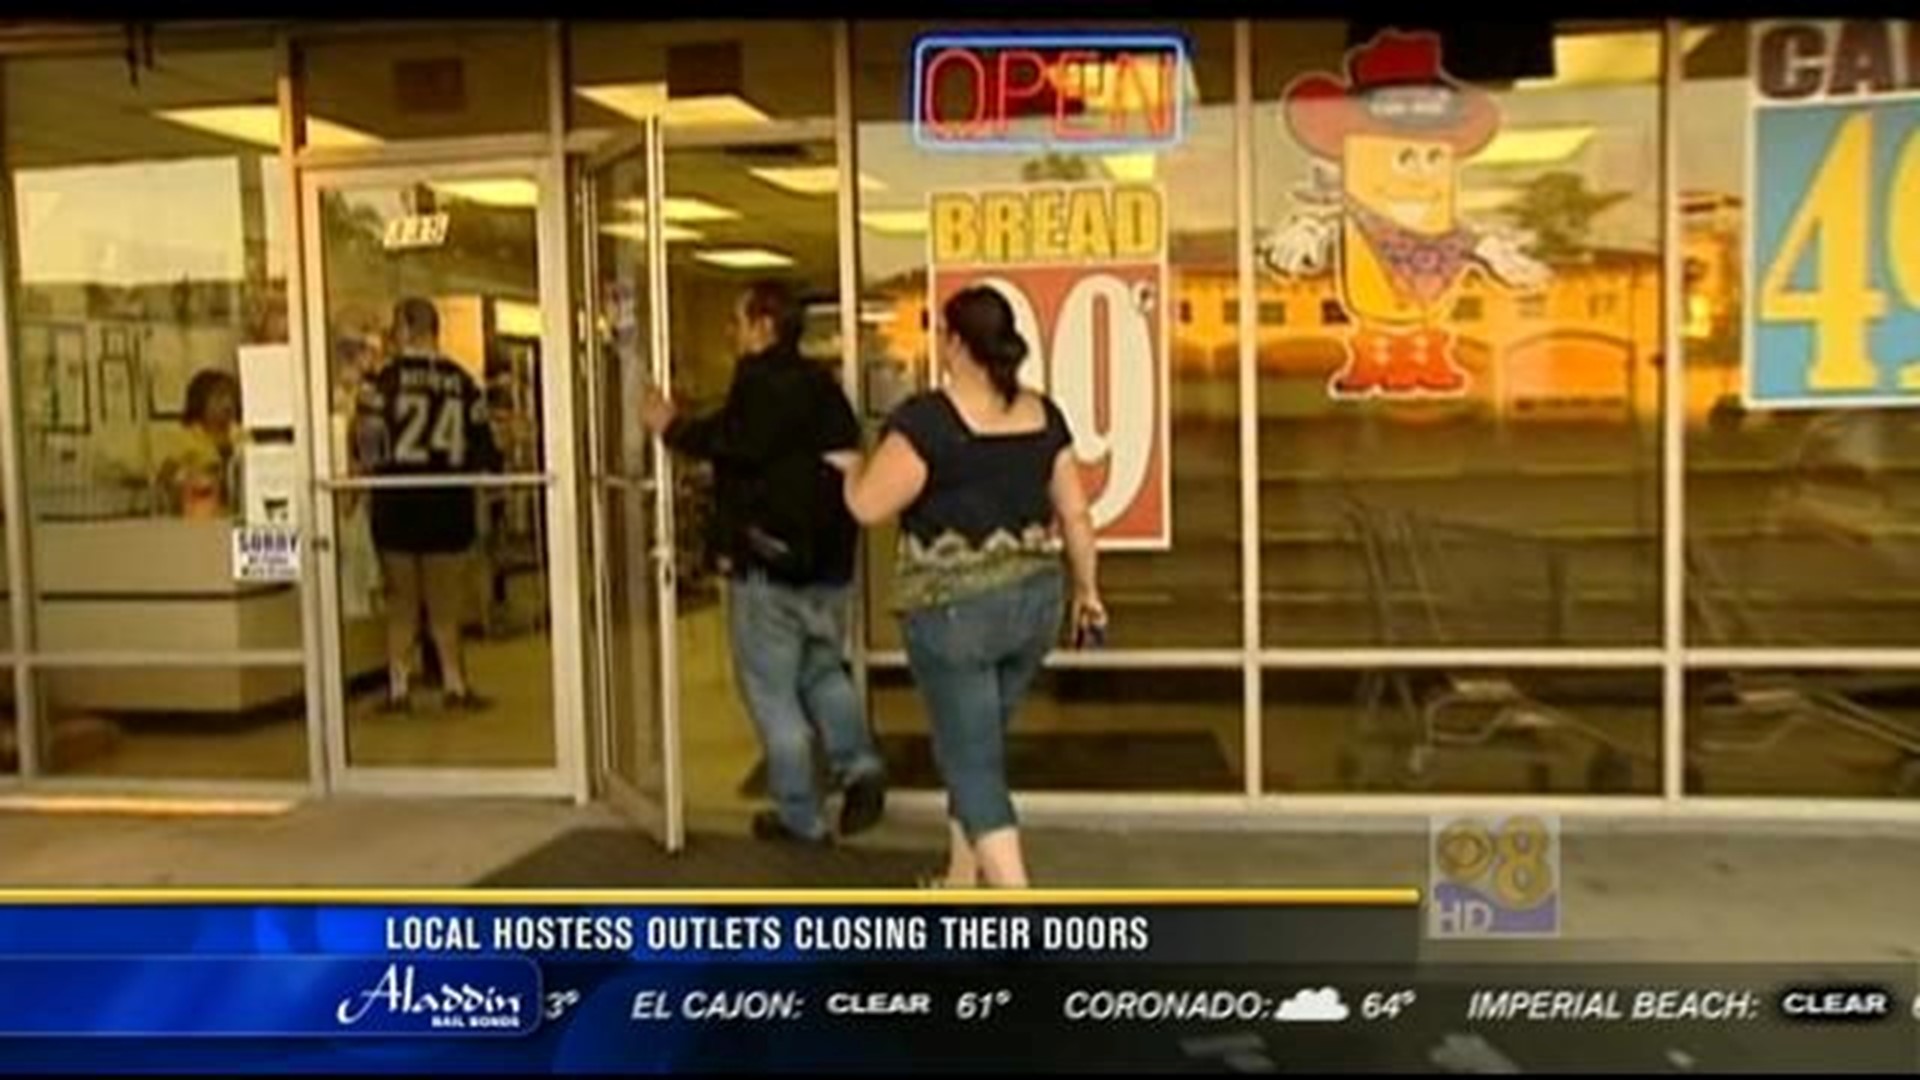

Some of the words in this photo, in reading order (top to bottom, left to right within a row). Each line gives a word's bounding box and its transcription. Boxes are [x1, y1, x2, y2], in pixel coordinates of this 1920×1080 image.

[925, 48, 1175, 138] OPEN
[1757, 24, 1920, 100] CA
[930, 186, 1161, 262] BREAD
[394, 395, 465, 466] 24
